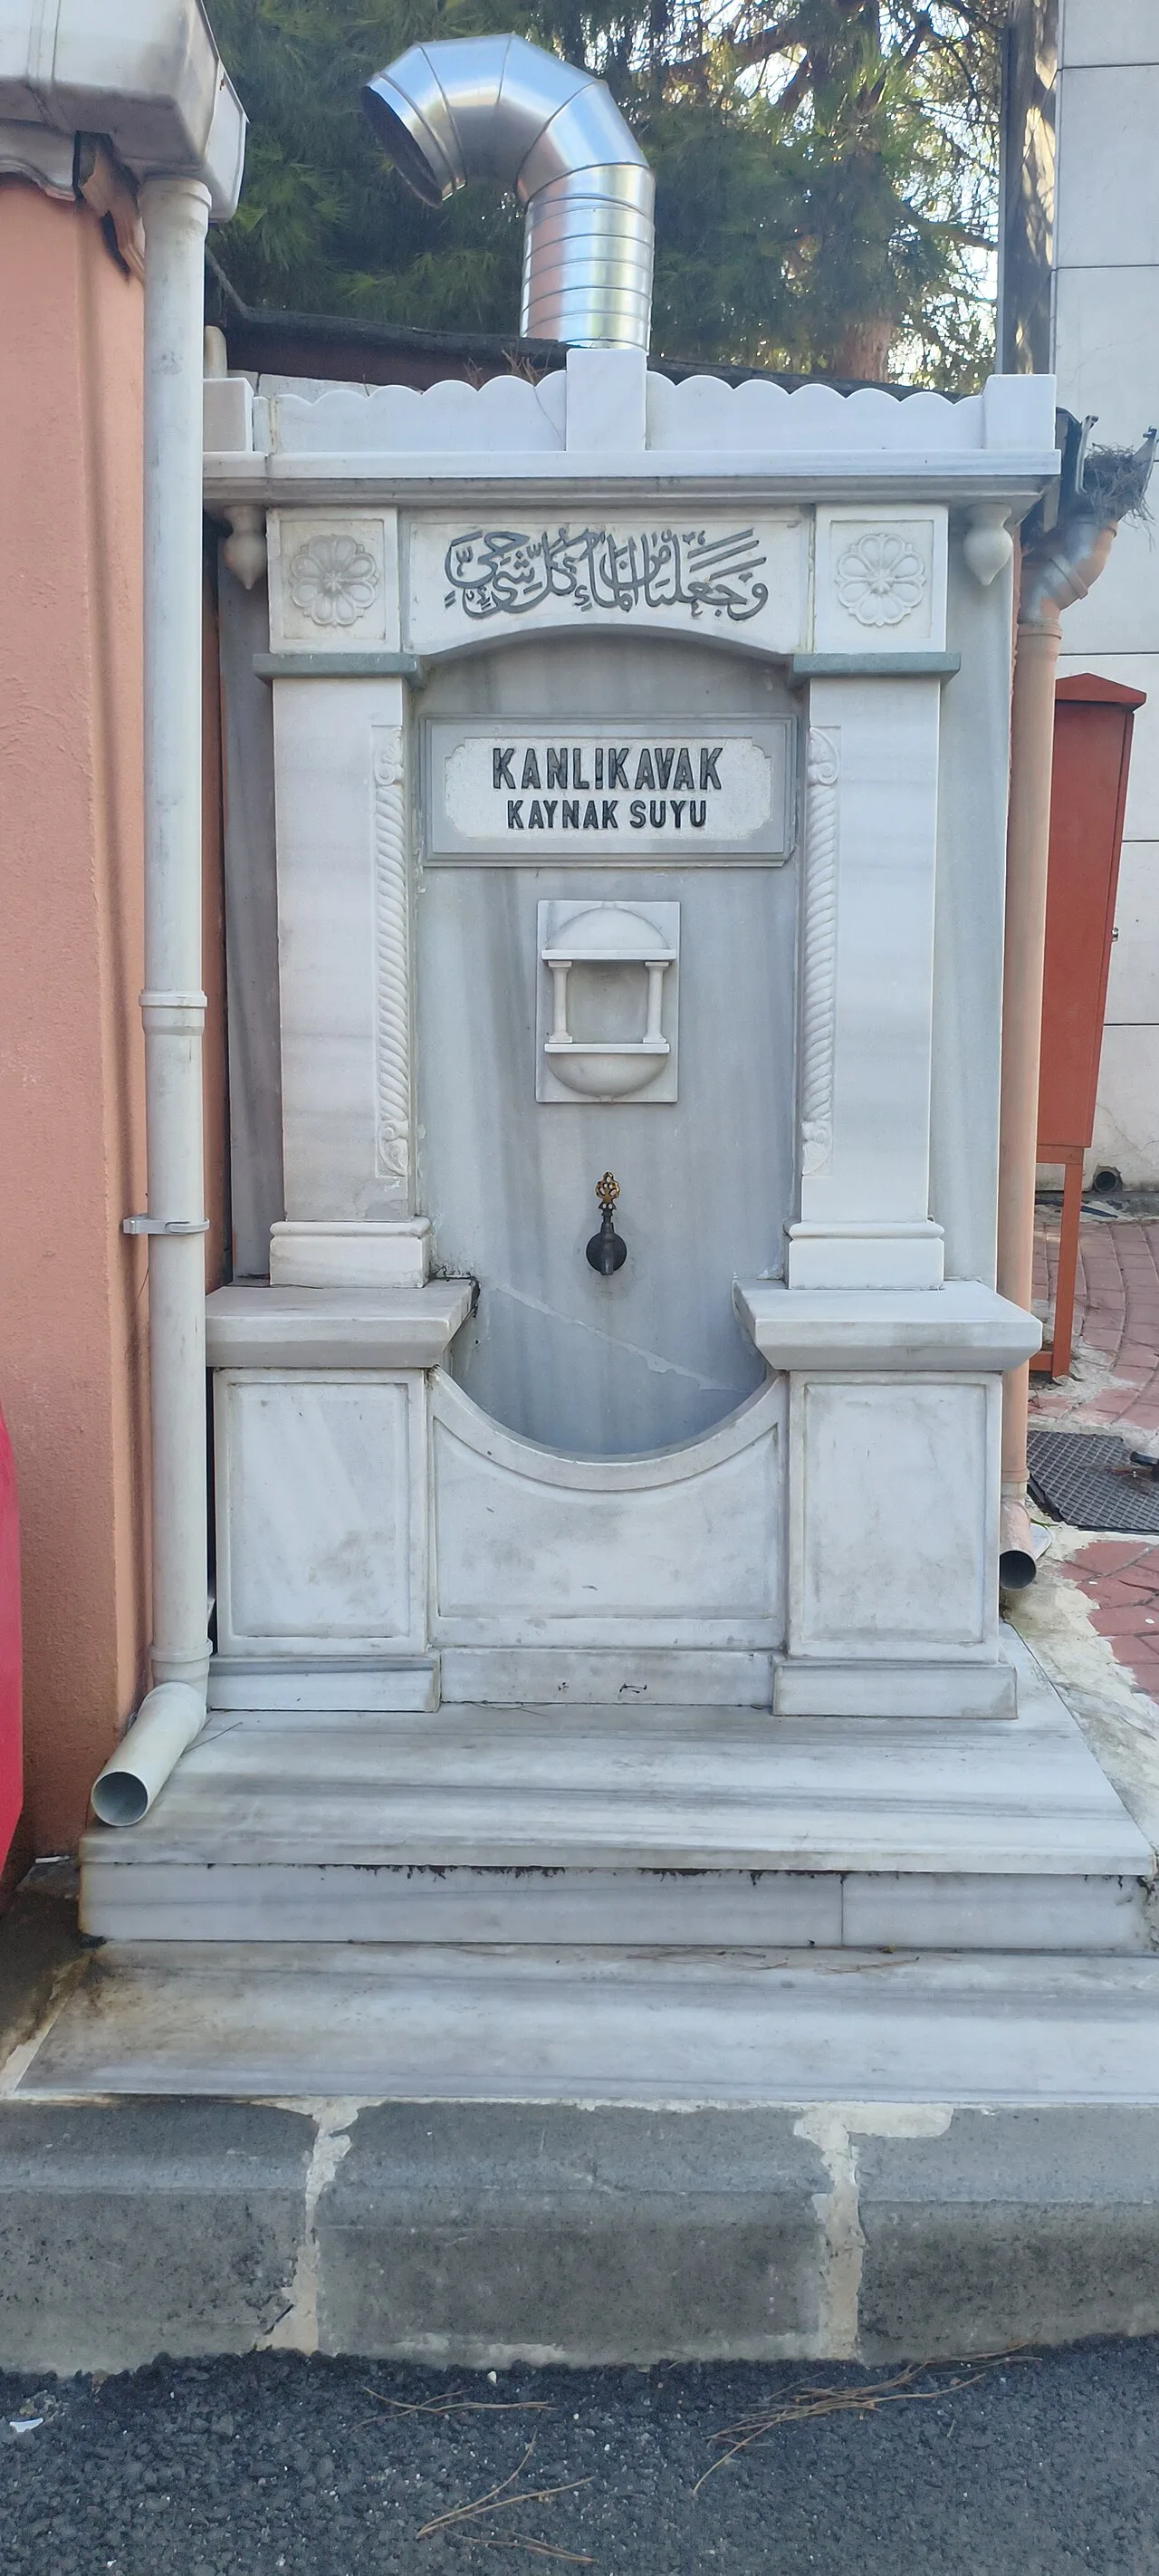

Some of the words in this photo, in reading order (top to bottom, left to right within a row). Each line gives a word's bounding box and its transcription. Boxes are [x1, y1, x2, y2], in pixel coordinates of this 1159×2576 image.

[493, 746, 723, 790] KANLIKAVAK
[507, 799, 619, 830] KAYNAK
[629, 799, 706, 829] SUYU
